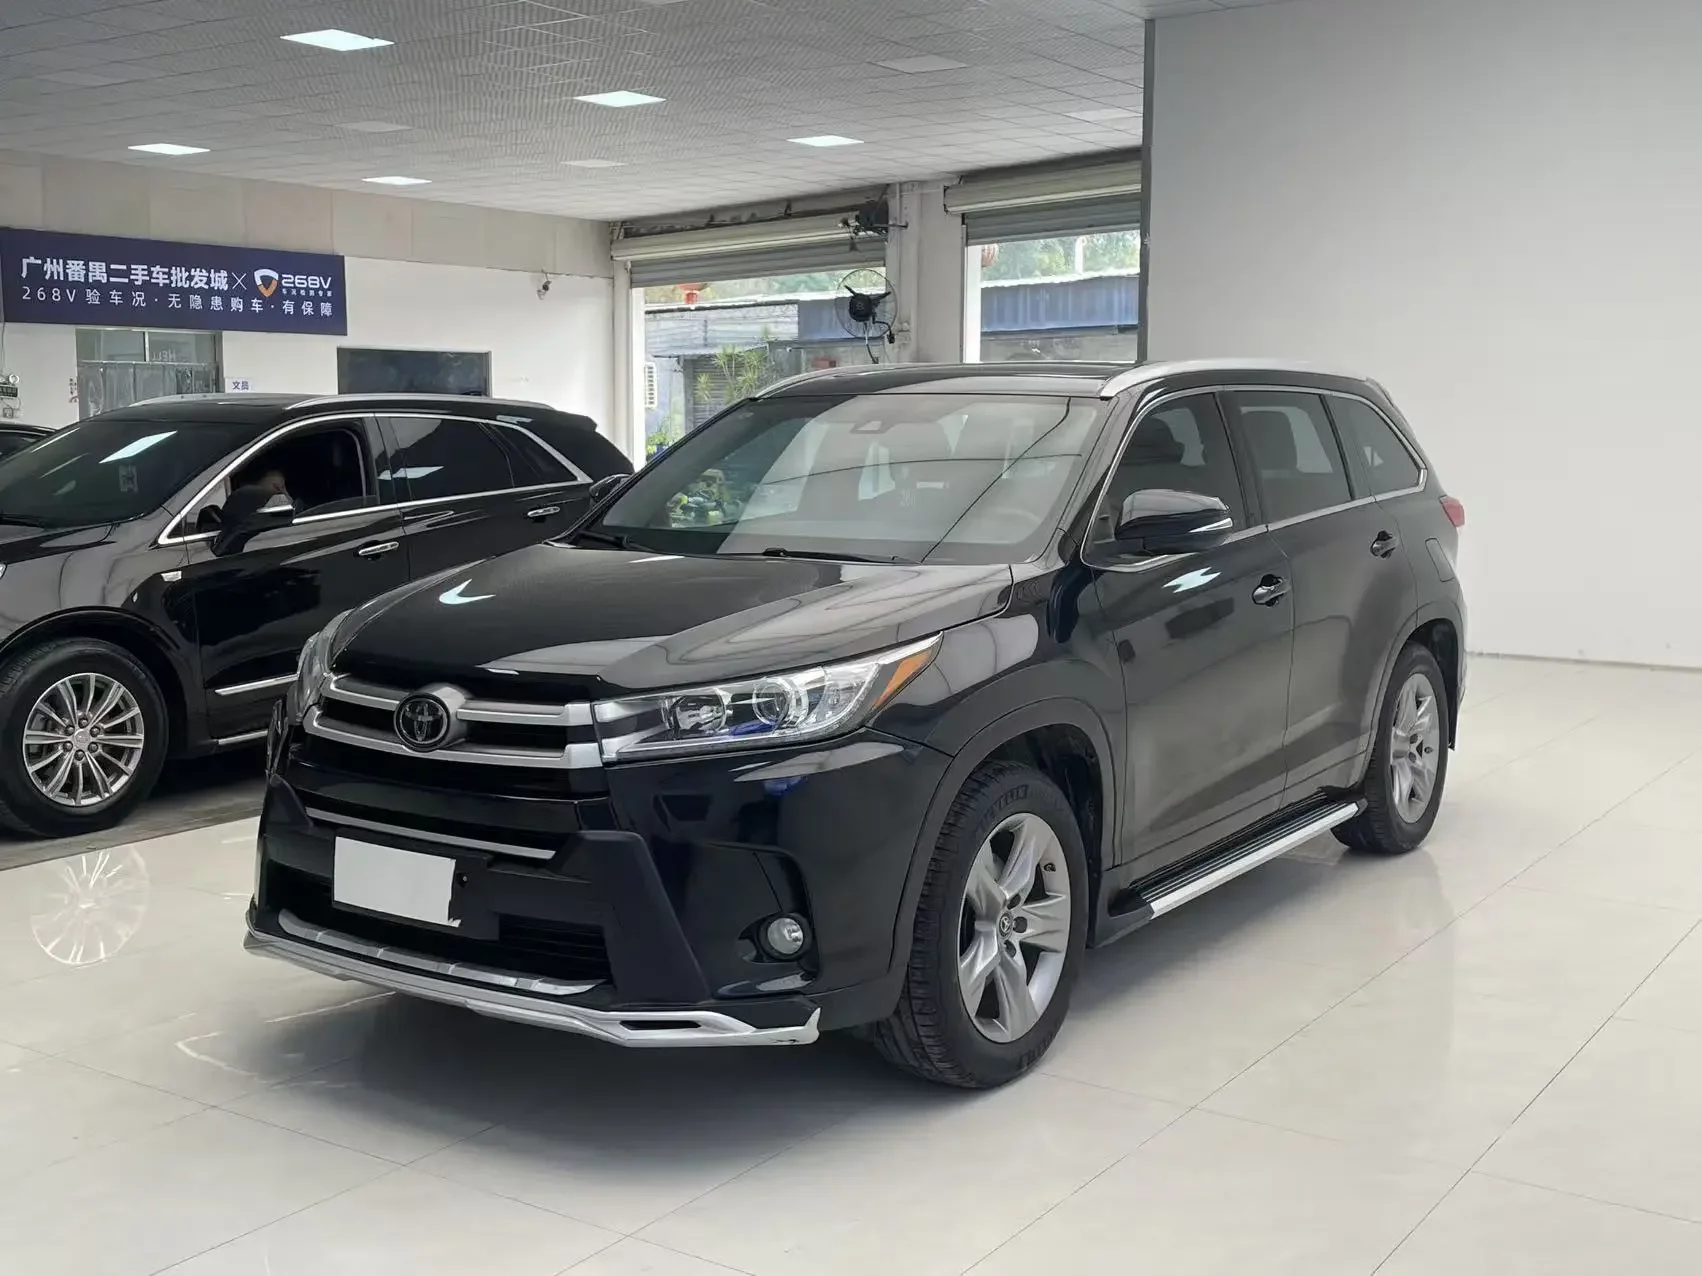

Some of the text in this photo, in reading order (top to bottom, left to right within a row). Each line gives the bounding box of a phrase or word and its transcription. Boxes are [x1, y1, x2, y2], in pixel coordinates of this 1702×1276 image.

[21, 257, 228, 291] 广州番禺二手车批发城
[281, 274, 332, 289] 268V
